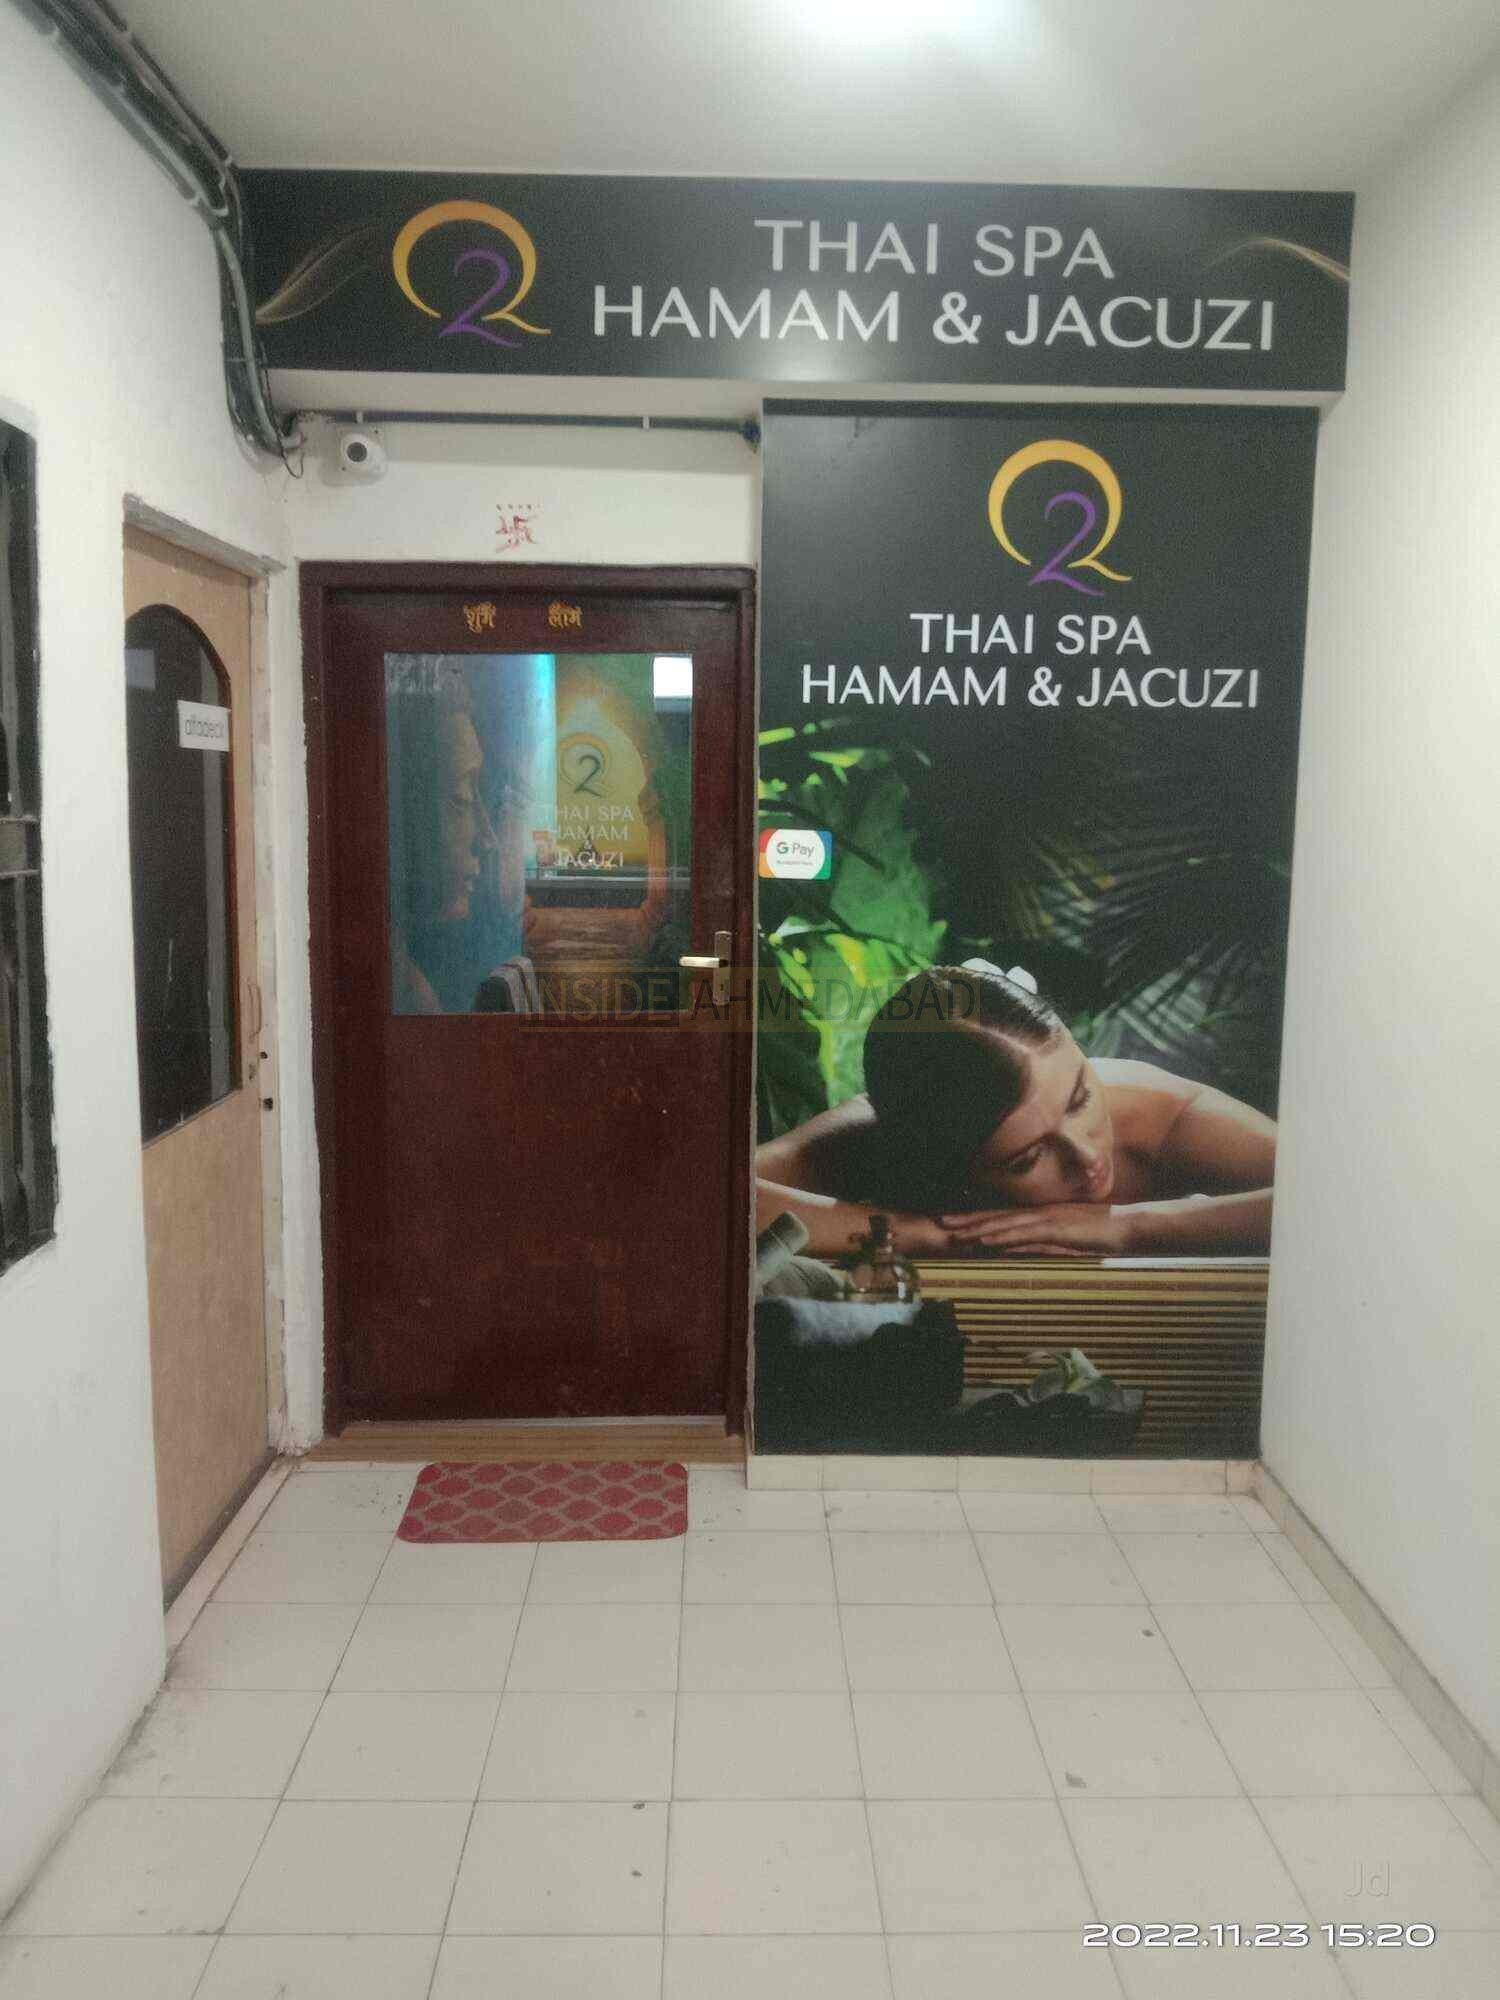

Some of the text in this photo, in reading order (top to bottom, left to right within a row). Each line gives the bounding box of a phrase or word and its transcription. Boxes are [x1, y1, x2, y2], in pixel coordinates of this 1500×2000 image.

[753, 218, 1116, 280] THAI SPA
[592, 284, 1275, 352] HAMAM & JACUZI
[909, 612, 1152, 657] THAI SPA
[802, 663, 1260, 709] HAMAM & JACUZI
[597, 805, 635, 822] SPA
[792, 842, 815, 859] Pay
